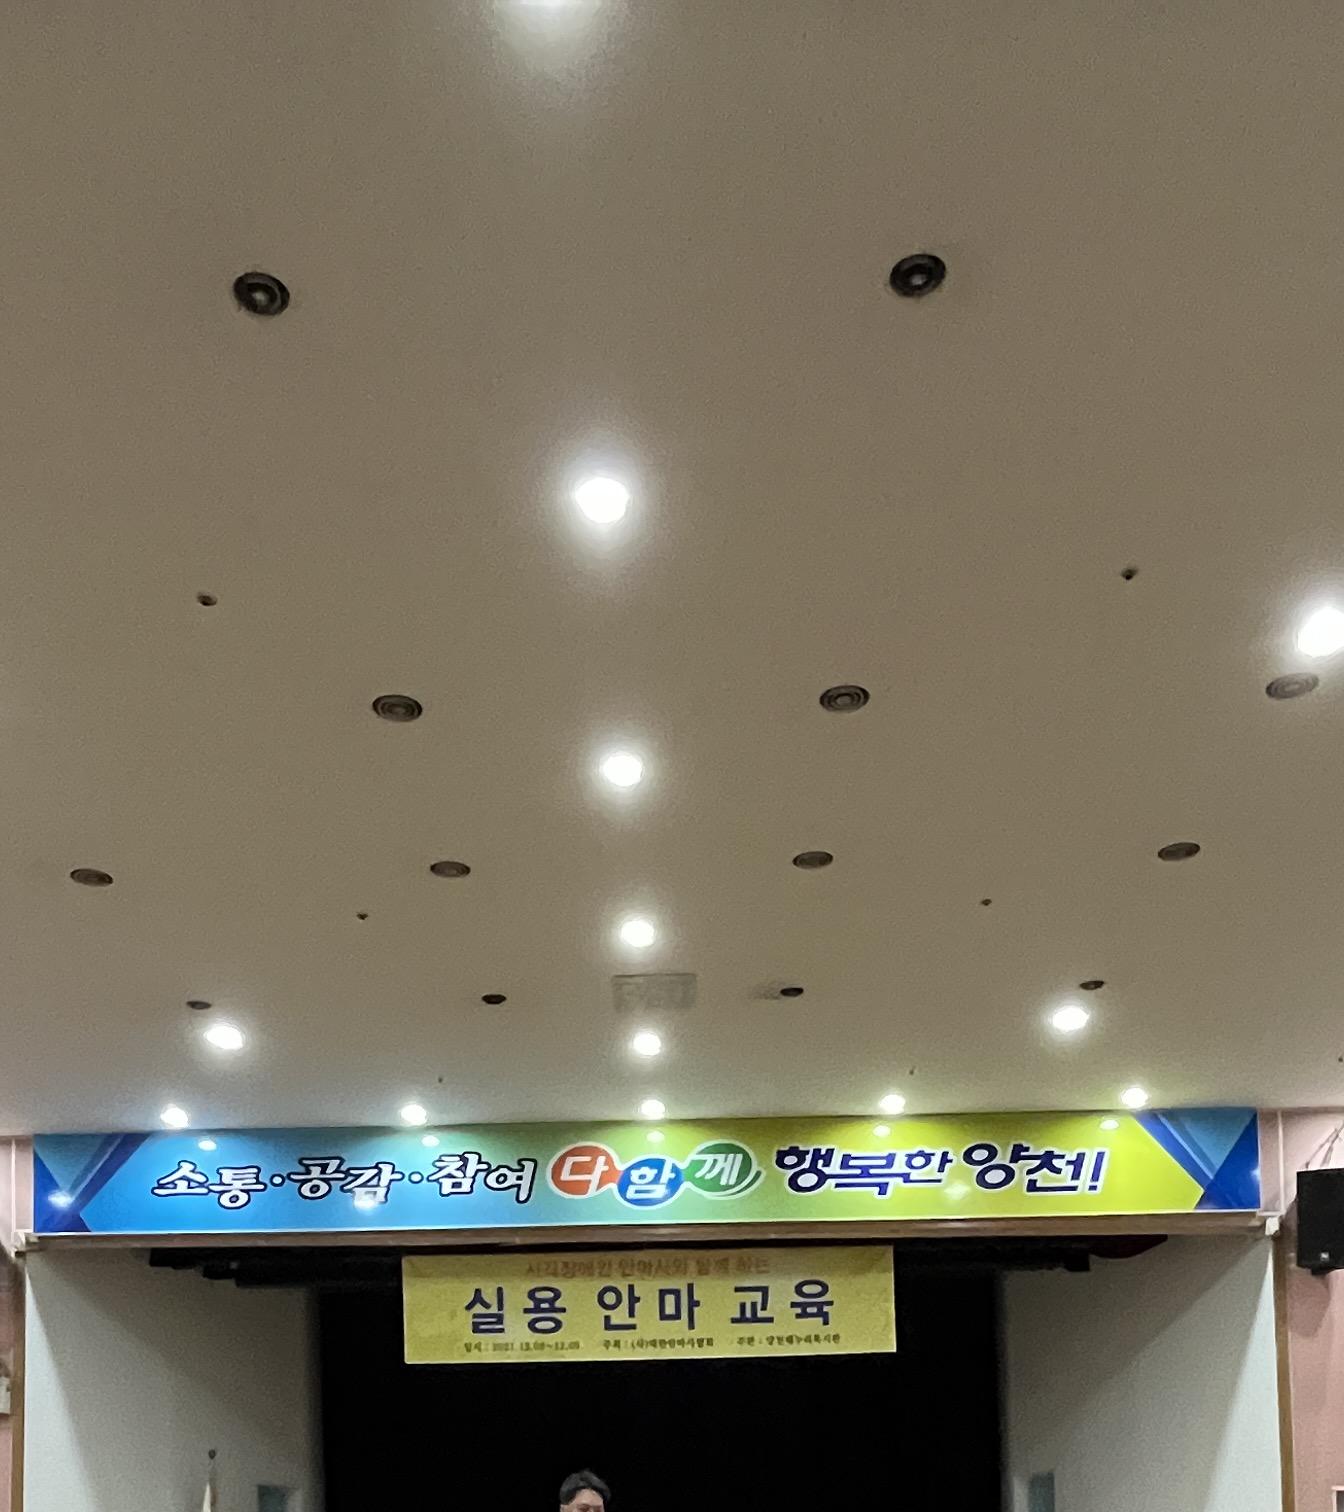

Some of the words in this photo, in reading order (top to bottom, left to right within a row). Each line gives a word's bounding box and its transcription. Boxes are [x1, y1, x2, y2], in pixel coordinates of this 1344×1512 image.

[554, 1146, 749, 1204] 다함께
[774, 1144, 954, 1199] 행복한
[961, 1141, 1106, 1195] 양천!
[464, 1285, 567, 1336] 실용
[596, 1282, 701, 1331] 안마
[729, 1278, 835, 1327] 교육
